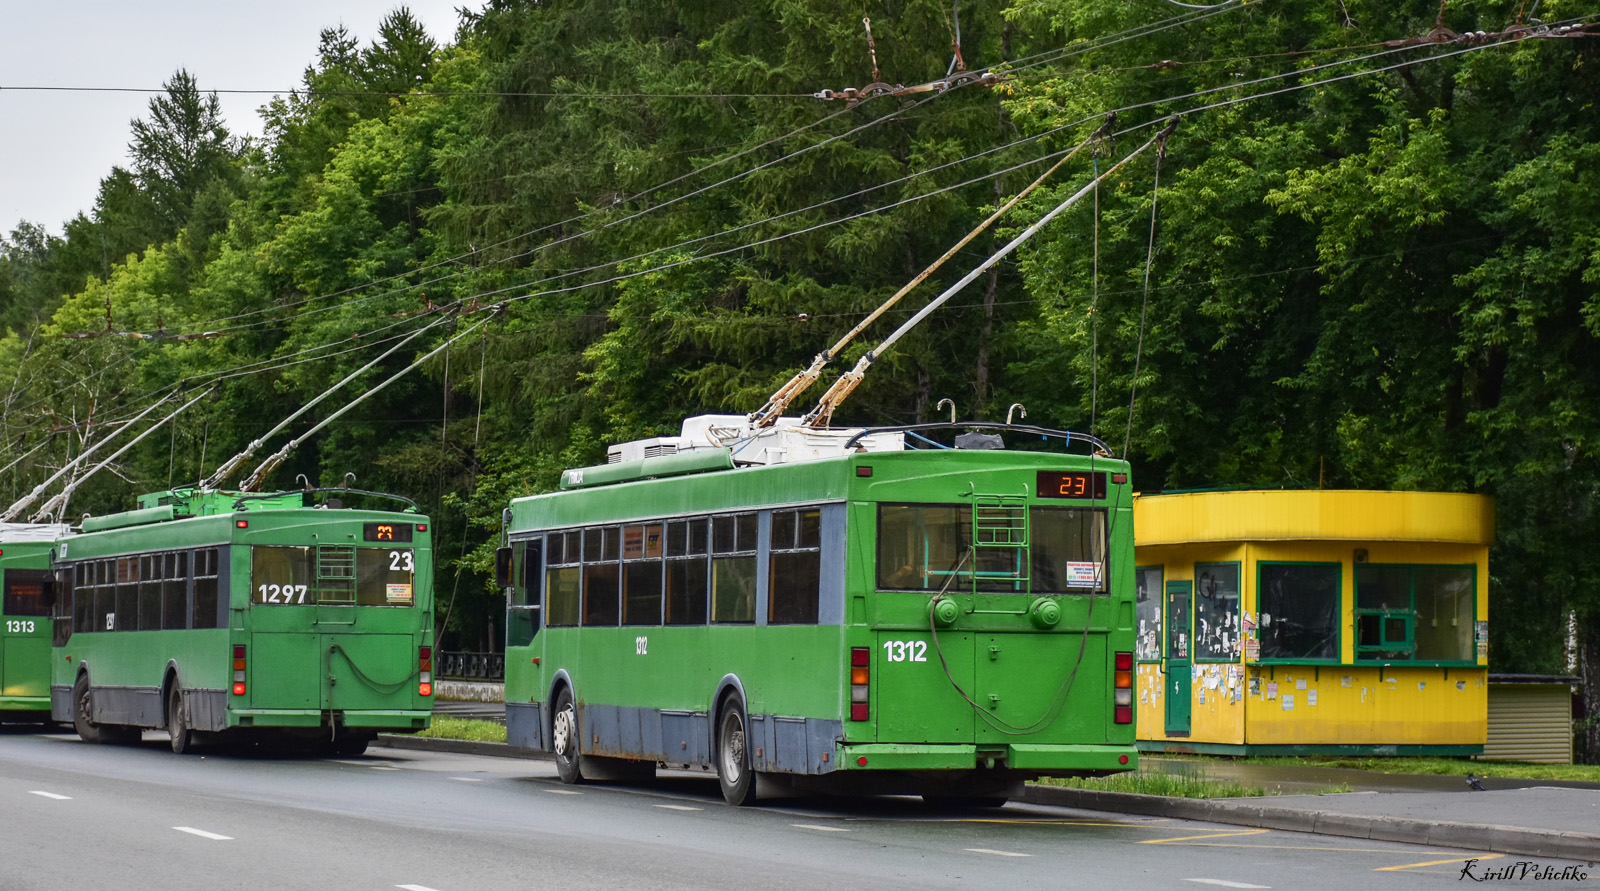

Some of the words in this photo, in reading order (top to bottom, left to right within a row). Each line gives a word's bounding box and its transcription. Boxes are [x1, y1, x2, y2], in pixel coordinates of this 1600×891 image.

[1059, 476, 1086, 495] 23
[389, 550, 412, 571] 23
[258, 584, 308, 604] 1297
[6, 620, 35, 633] 1313
[635, 636, 648, 655] 1312
[883, 639, 928, 663] 1312
